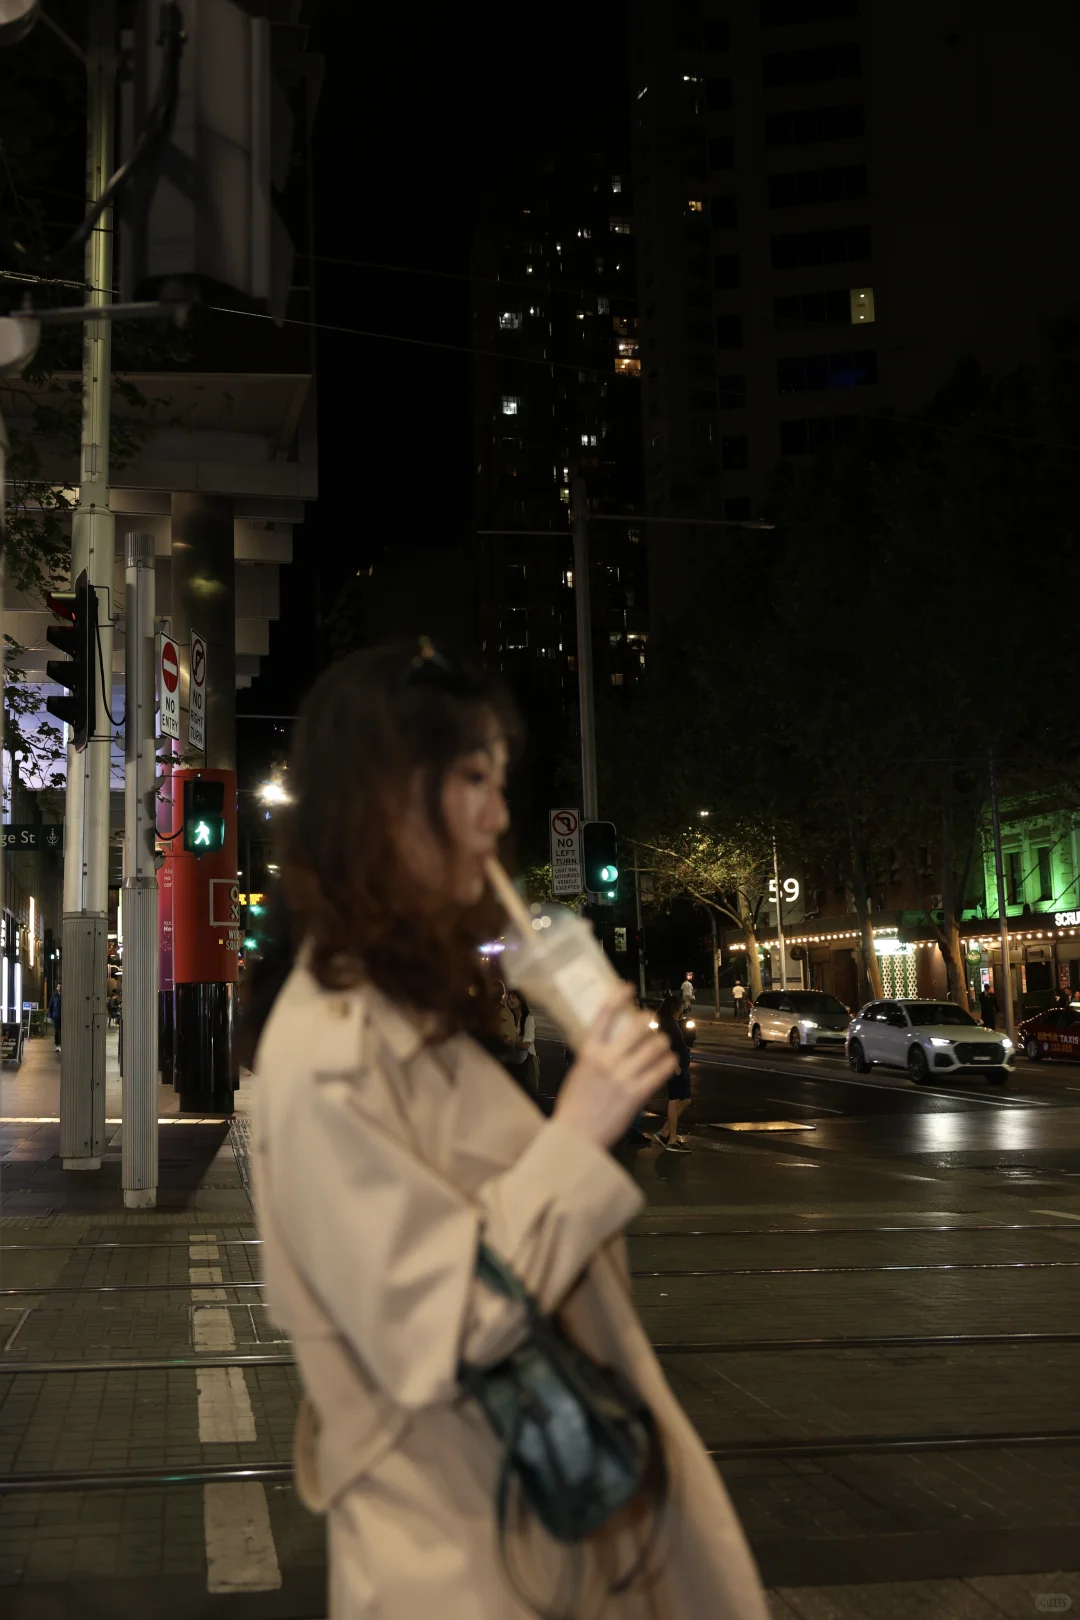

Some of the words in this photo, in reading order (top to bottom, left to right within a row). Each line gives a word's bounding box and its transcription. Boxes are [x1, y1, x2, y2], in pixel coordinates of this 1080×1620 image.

[166, 696, 174, 713] NO
[192, 690, 202, 709] NO
[162, 714, 179, 732] ENTRY
[20, 830, 36, 843] St
[558, 838, 574, 848] NO
[768, 878, 799, 902] 59
[1060, 1034, 1079, 1045] TAXIS
